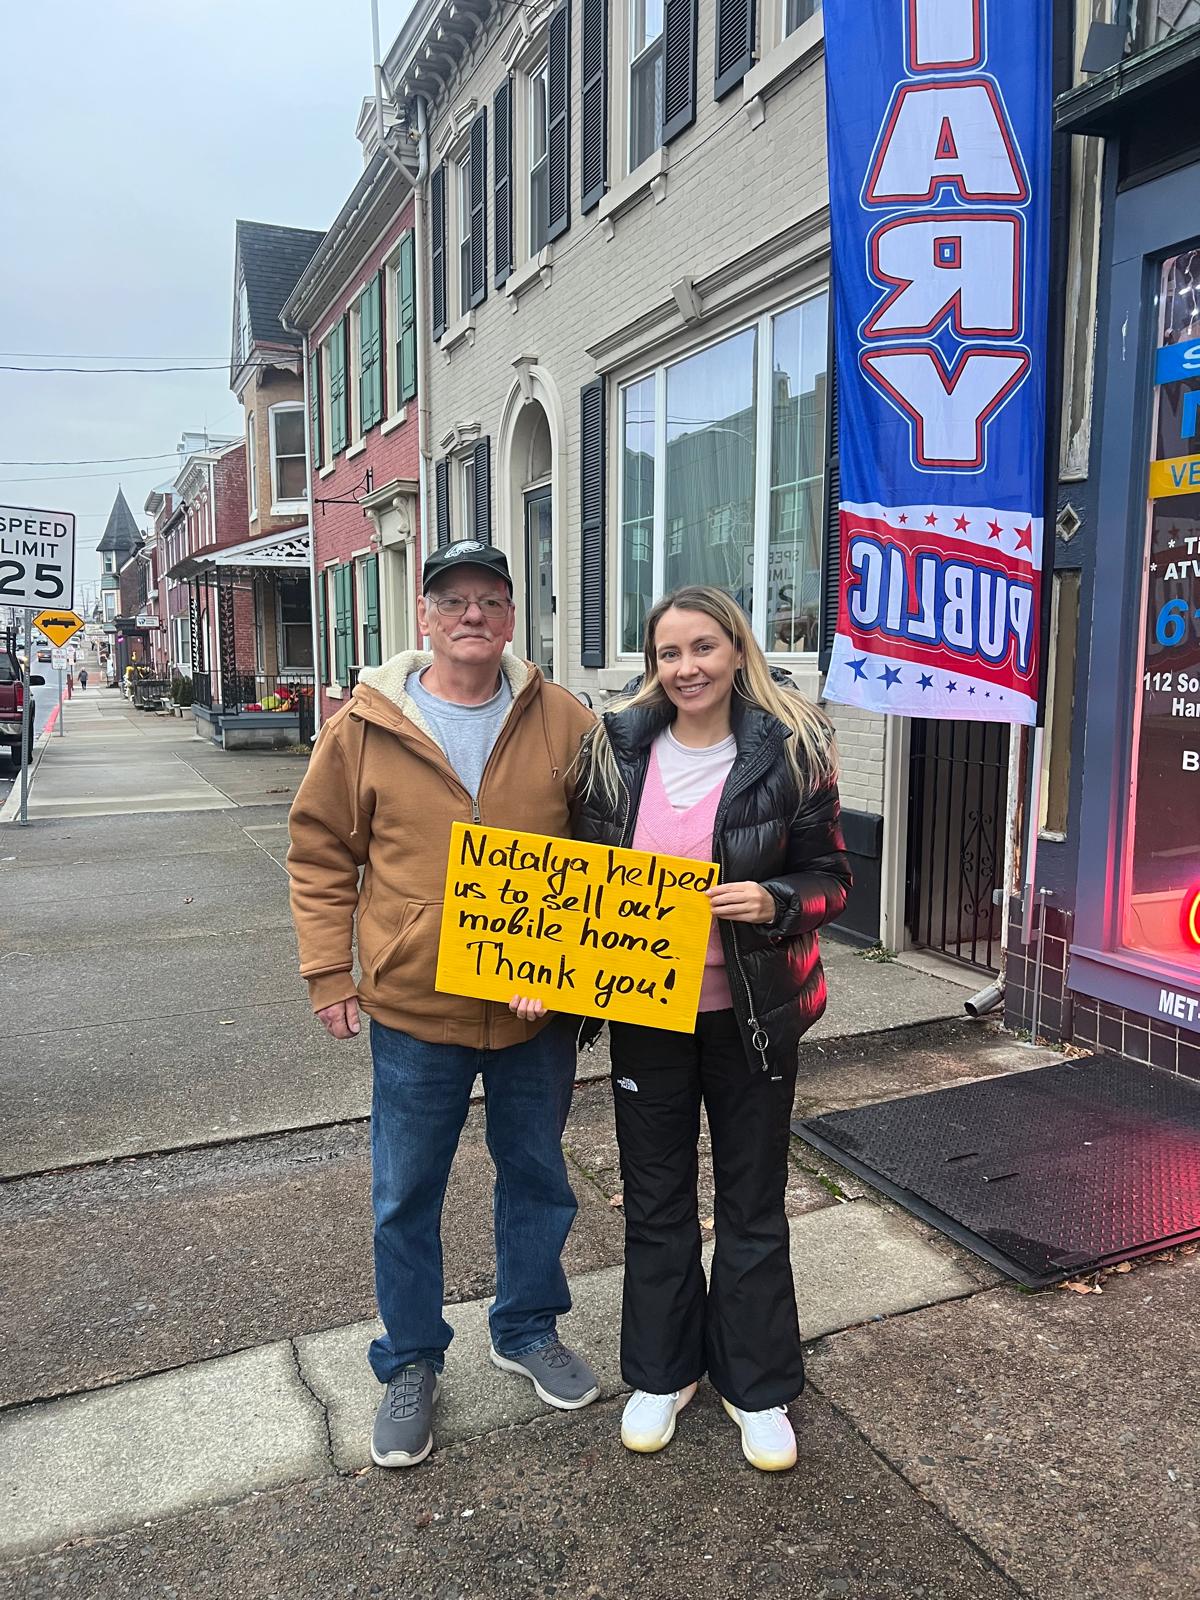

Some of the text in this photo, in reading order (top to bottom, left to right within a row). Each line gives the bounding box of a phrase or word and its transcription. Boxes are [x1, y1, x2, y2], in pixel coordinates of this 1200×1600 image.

[0, 516, 67, 538] SPEED
[1, 538, 59, 559] LIMIT
[0, 560, 64, 599] 25
[1144, 672, 1172, 692] 112
[1182, 750, 1200, 772] B
[460, 830, 715, 908] Natalya helped
[454, 878, 675, 921] us to sell our
[459, 906, 563, 942] mobile
[466, 940, 676, 1009] Thank you!
